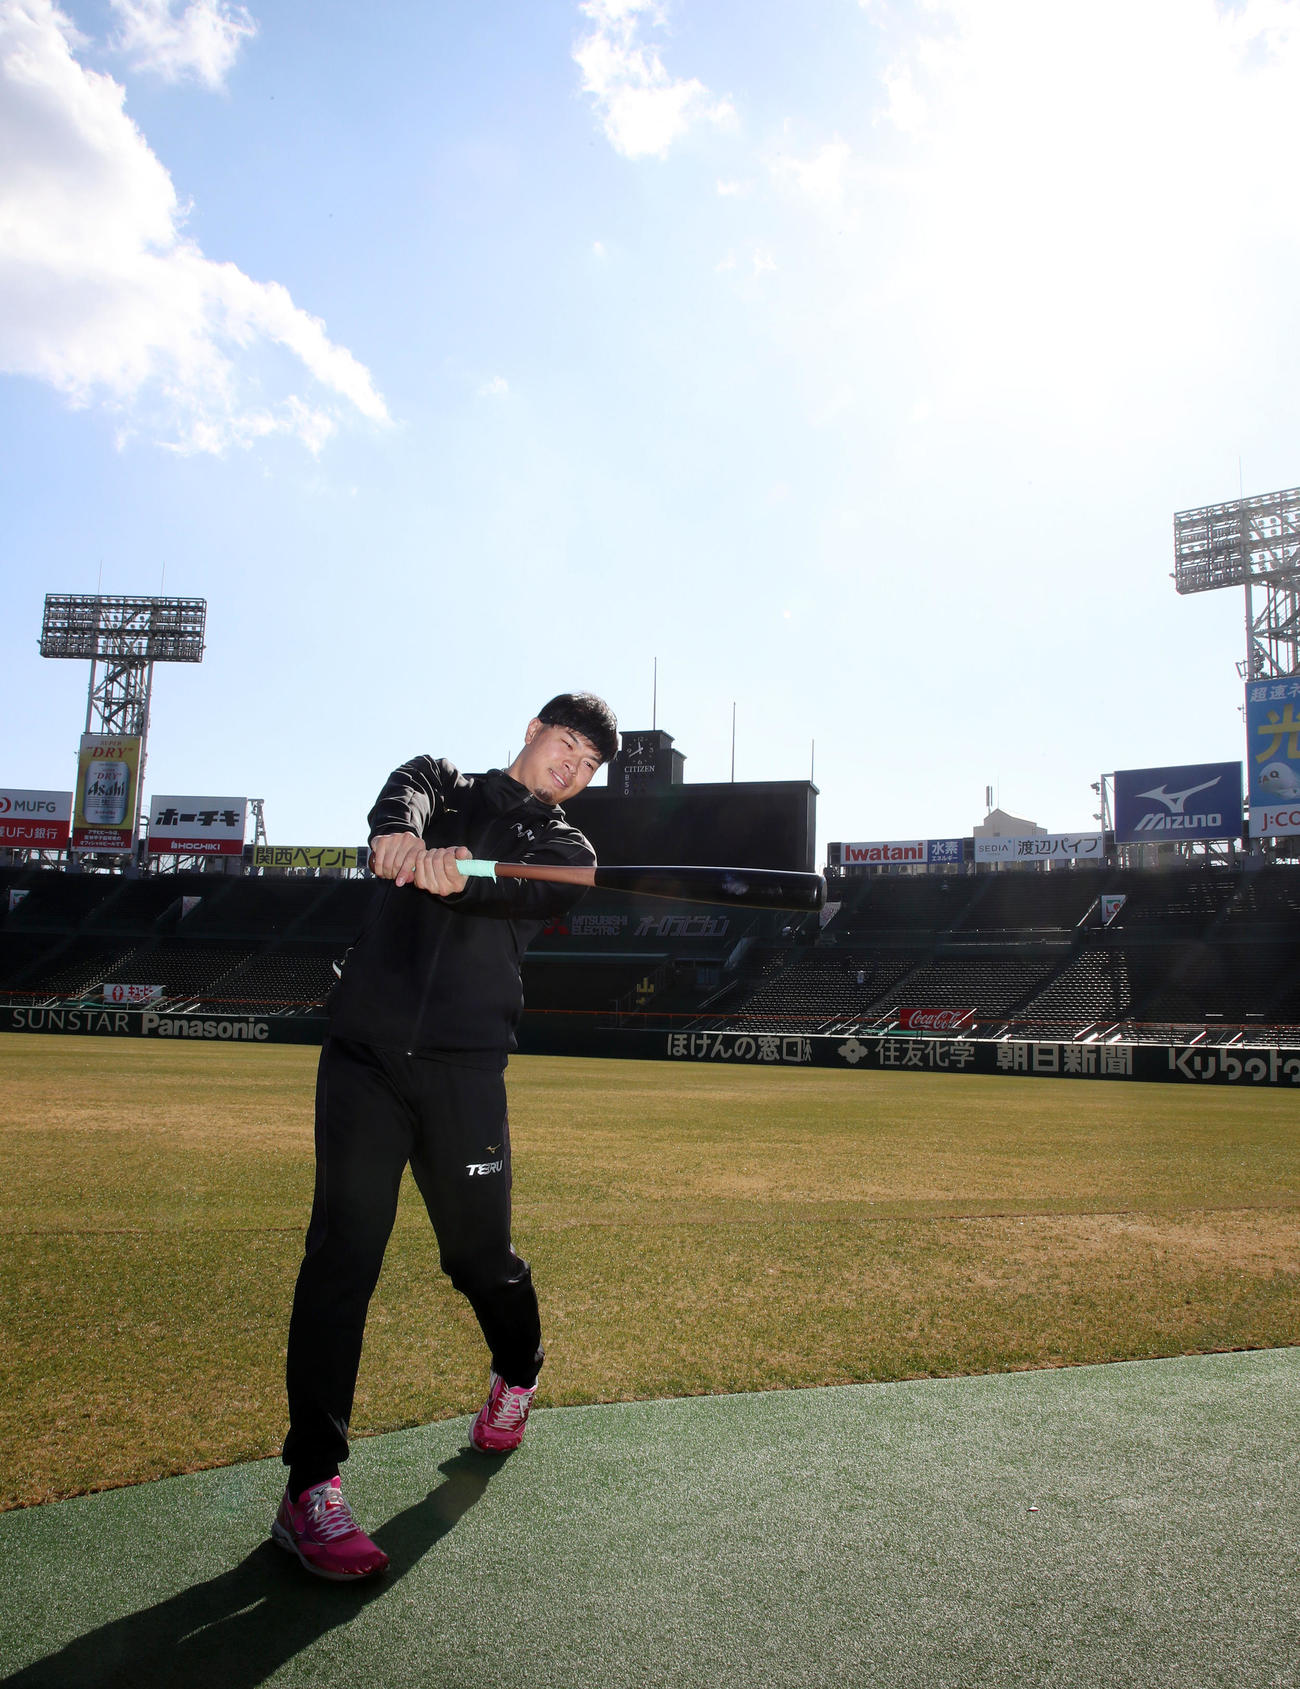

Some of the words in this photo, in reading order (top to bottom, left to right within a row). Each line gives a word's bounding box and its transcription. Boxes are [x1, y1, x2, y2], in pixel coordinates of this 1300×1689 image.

[624, 765, 656, 773] CITIZEN
[87, 780, 126, 797] Asahi
[14, 801, 56, 812] MUFG
[155, 808, 240, 827] ホーチキ
[177, 842, 221, 850] HOCHIKI
[845, 842, 924, 861] Iwatani
[931, 841, 959, 855] 水素
[1017, 835, 1102, 855] 渡辺パイプ
[255, 847, 356, 866] 関西ペイント
[12, 1008, 129, 1032] SUNSTAR
[142, 1012, 269, 1040] Panasonic
[667, 1033, 801, 1062] ほけんの窓口
[875, 1038, 975, 1068] 住友化学
[996, 1043, 1133, 1075] 朝日新聞
[465, 1160, 503, 1176] TERU
